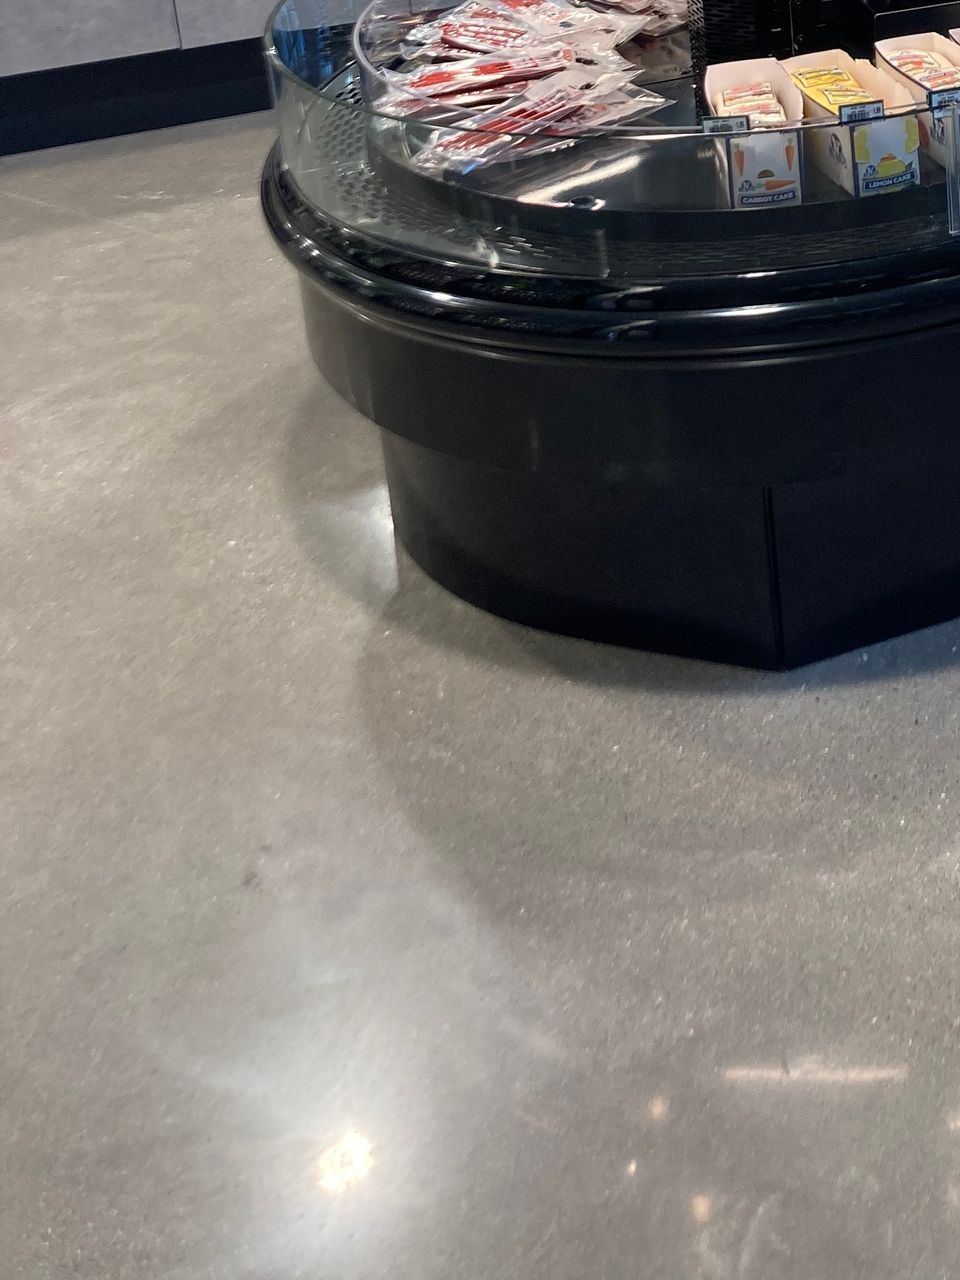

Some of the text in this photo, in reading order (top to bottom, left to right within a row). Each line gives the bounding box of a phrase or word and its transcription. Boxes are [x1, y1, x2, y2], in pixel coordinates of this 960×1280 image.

[868, 173, 913, 190] LEMON CAKE
[741, 190, 795, 206] CARROT CAKE
